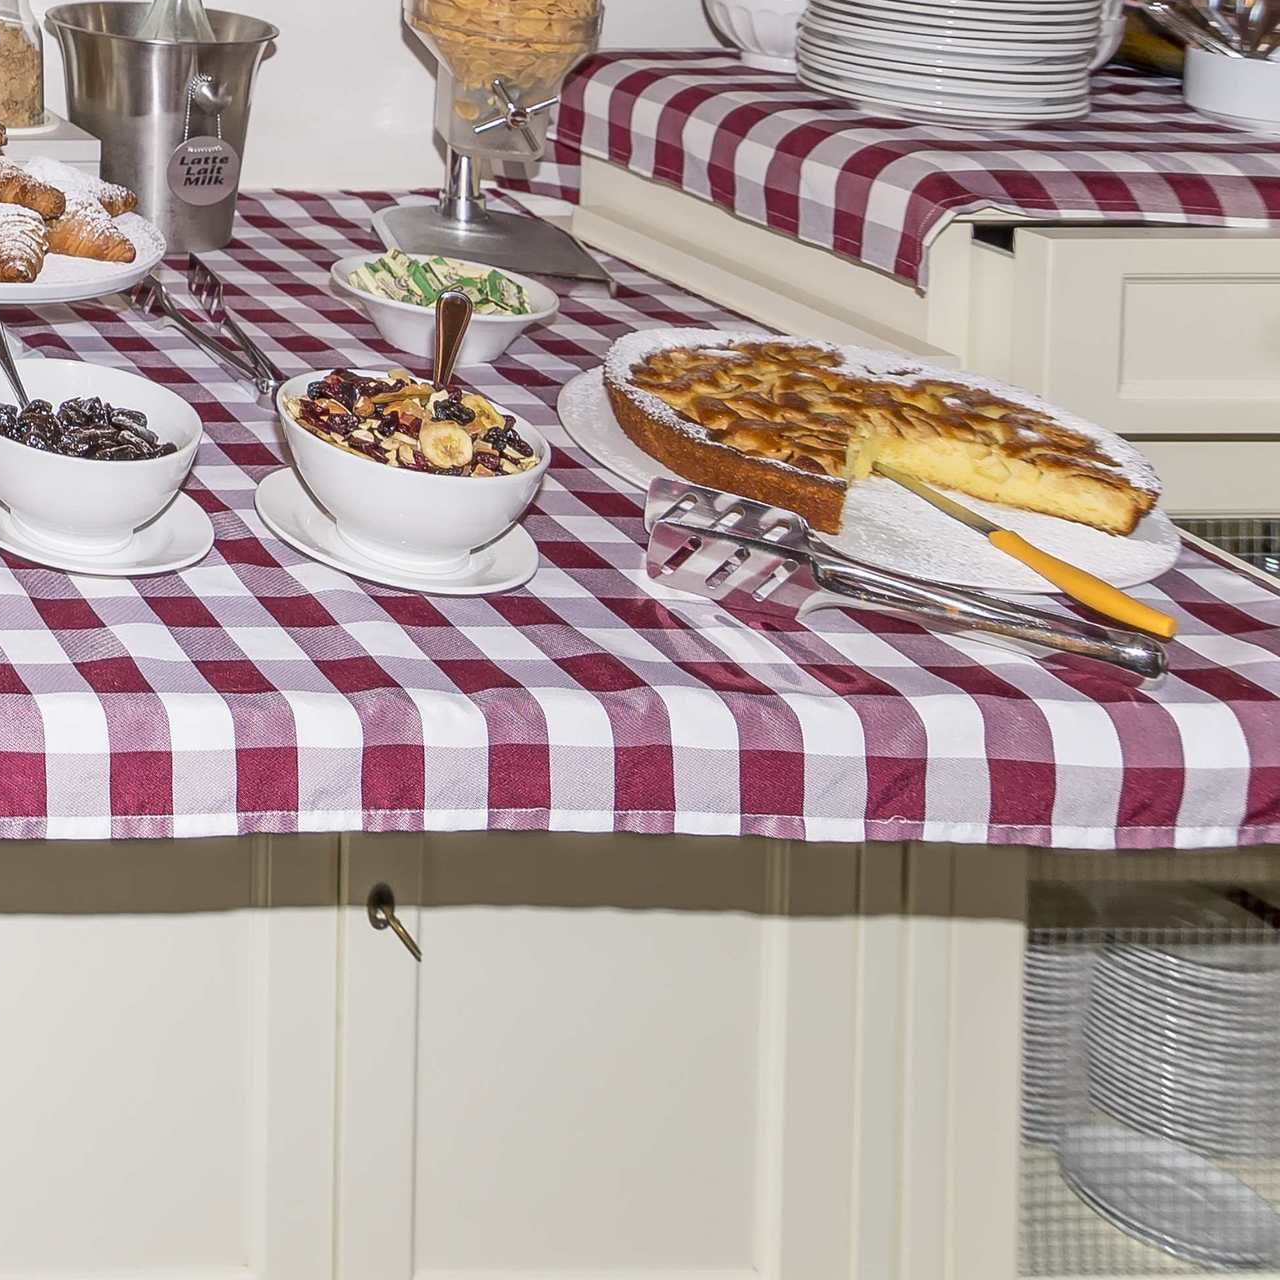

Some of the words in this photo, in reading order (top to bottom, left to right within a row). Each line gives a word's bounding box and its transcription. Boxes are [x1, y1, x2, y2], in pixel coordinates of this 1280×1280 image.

[179, 156, 229, 166] Latte
[185, 166, 223, 176] Lait
[183, 176, 225, 186] Milk
